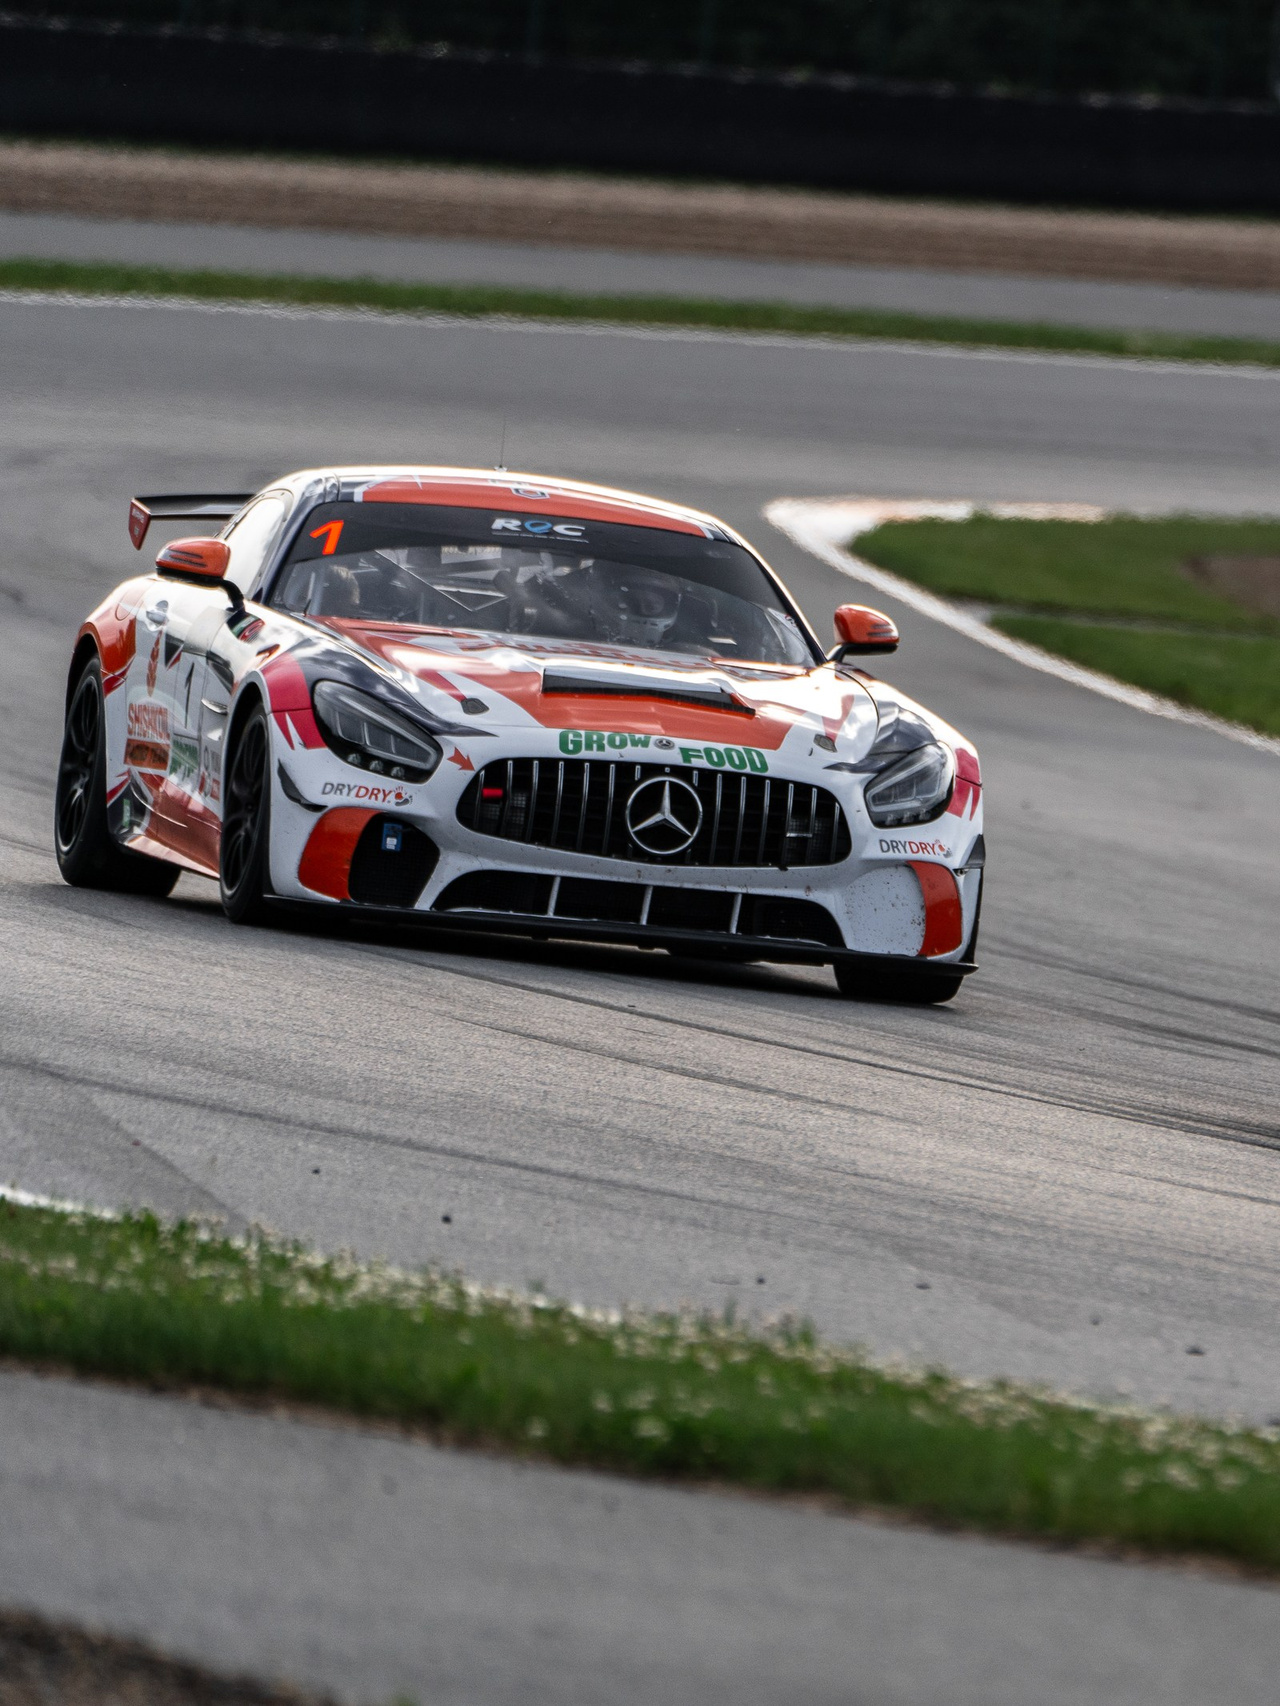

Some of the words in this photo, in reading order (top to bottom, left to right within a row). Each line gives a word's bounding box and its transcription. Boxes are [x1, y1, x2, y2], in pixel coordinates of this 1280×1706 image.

[309, 519, 345, 555] 1
[558, 729, 652, 755] GROW
[678, 746, 769, 774] FOOD
